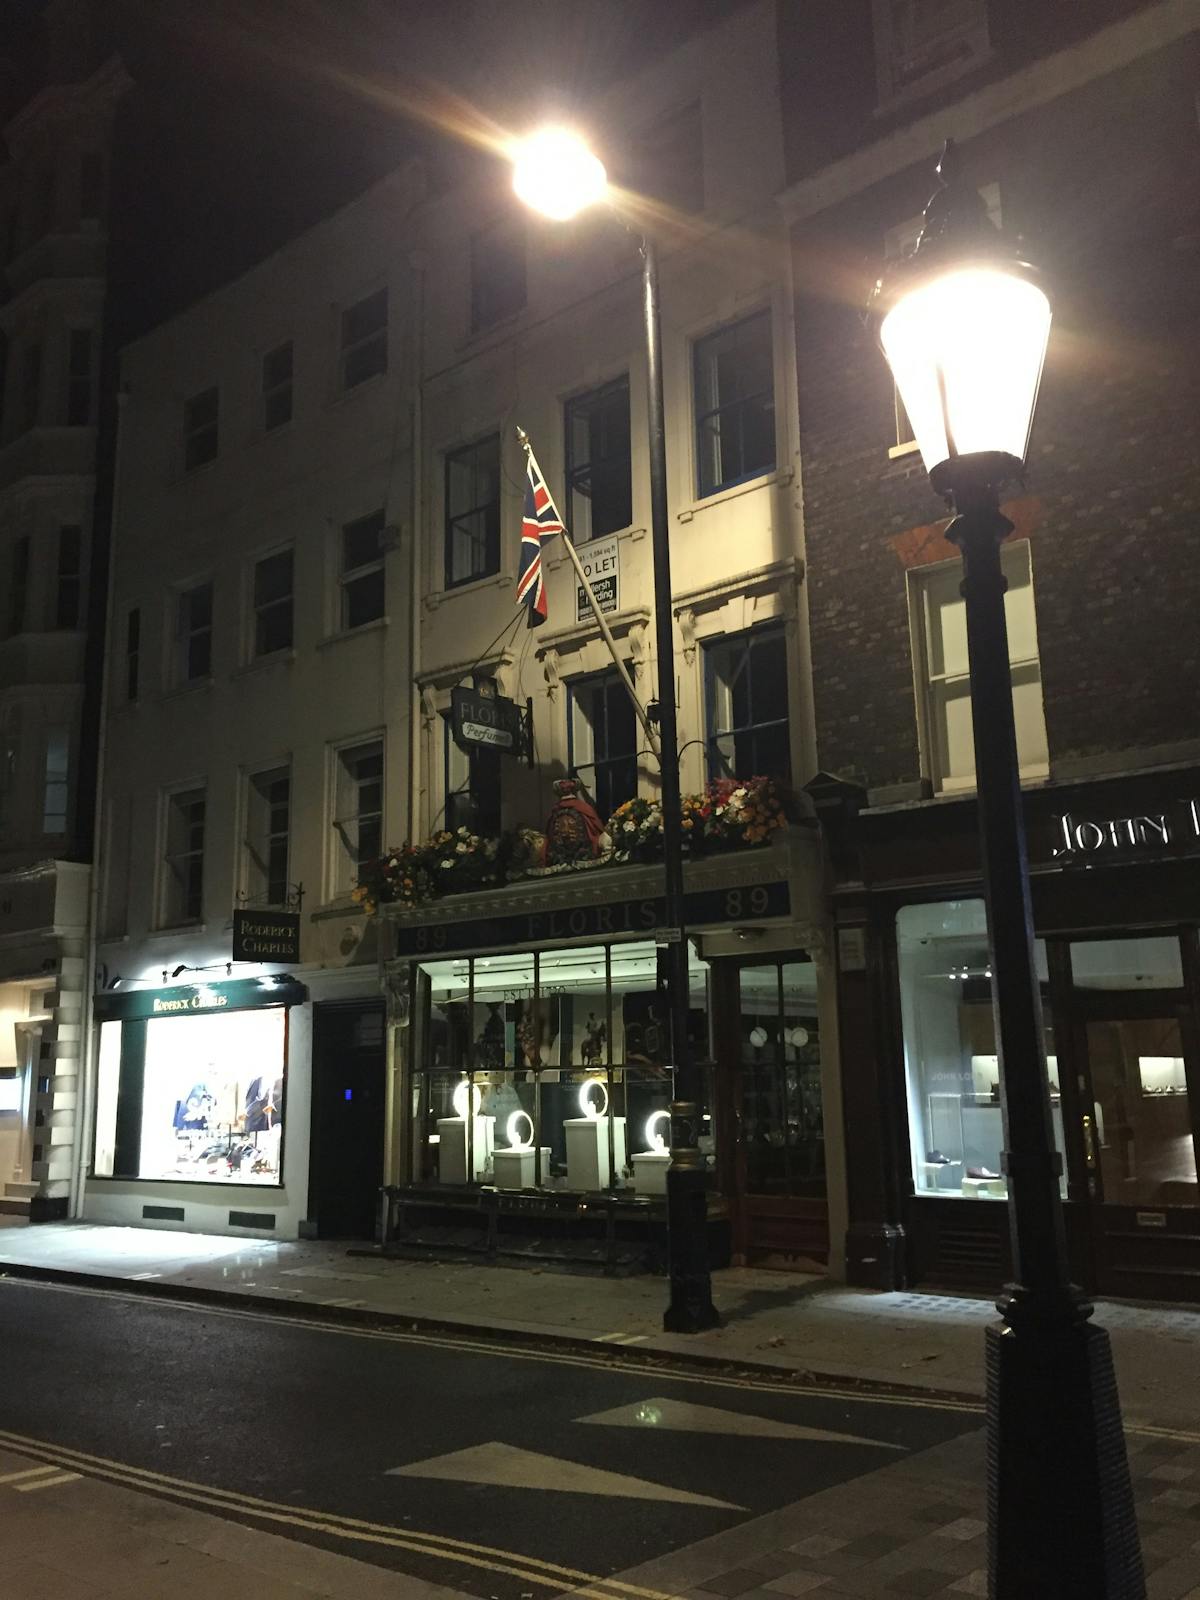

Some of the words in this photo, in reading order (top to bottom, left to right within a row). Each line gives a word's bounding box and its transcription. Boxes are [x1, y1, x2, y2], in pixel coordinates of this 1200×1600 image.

[596, 556, 617, 574] LET
[461, 702, 513, 730] FLOI
[726, 886, 769, 918] 89
[528, 901, 657, 939] FLORIS
[416, 925, 449, 951] 89
